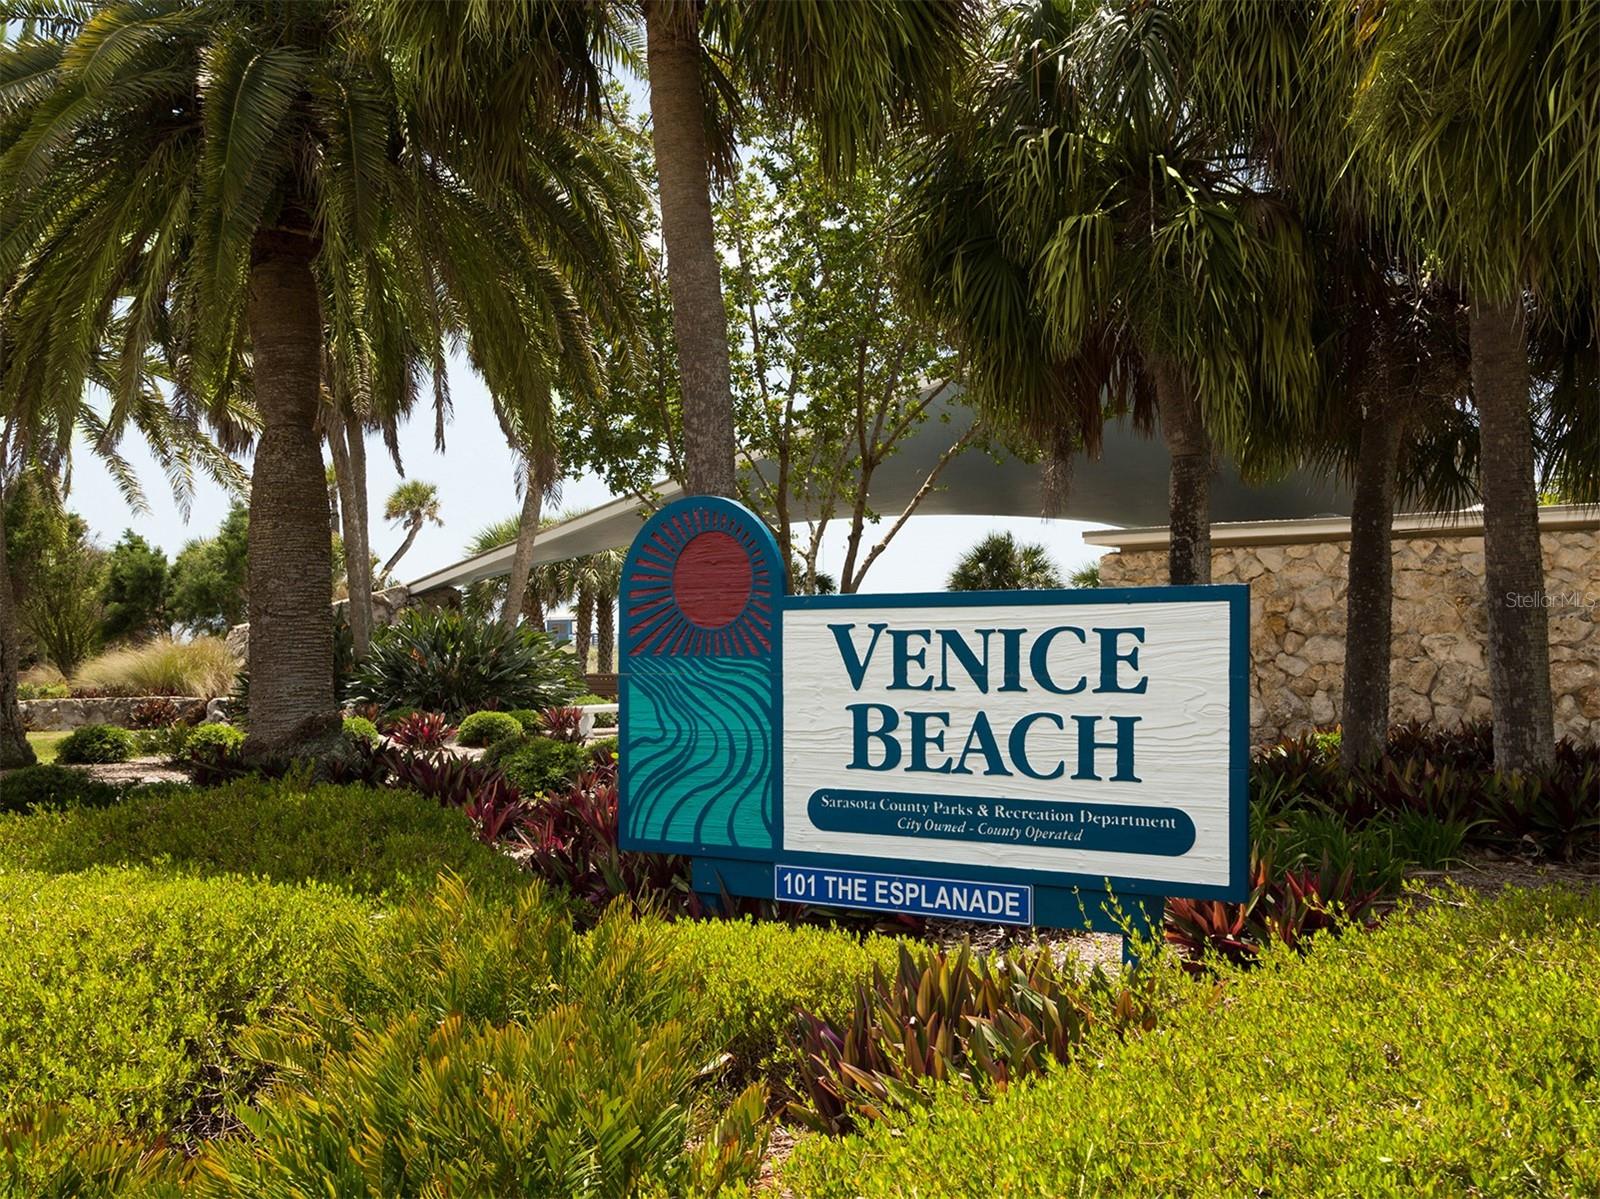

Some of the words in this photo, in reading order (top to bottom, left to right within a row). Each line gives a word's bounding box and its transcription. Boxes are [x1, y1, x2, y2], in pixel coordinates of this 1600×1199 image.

[827, 623, 1148, 694] VENICE
[845, 703, 1142, 783] BEACH
[821, 794, 876, 810] Sarasota
[879, 798, 930, 816] County
[933, 801, 973, 817] Parks
[976, 804, 989, 816] &
[994, 804, 1074, 823] Recreation
[1080, 809, 1176, 829] Department
[897, 816, 922, 833] City
[924, 819, 966, 833] Owned
[977, 822, 1022, 840] County
[1025, 825, 1084, 842] Operated
[783, 872, 816, 897] 101
[823, 875, 868, 902] THE
[874, 879, 1021, 917] ESPLANADE
